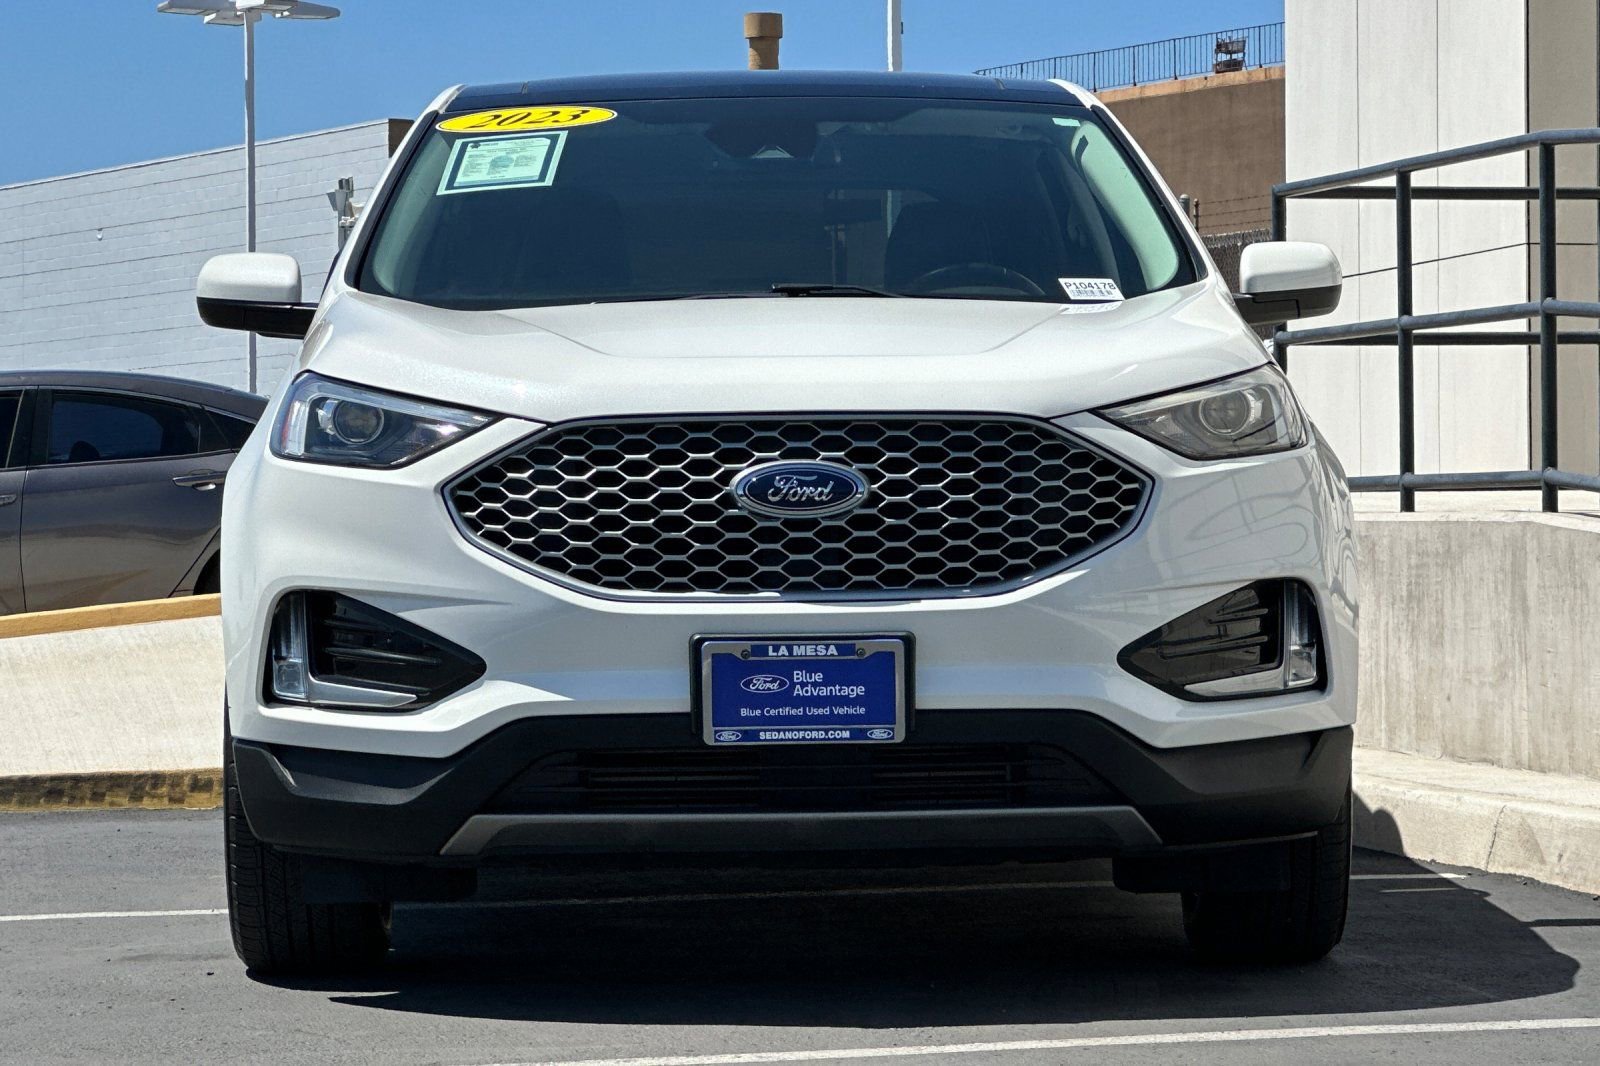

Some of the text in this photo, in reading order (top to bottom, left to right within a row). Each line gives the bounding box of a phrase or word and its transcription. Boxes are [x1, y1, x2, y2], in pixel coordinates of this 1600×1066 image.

[466, 109, 591, 129] 2023
[767, 474, 834, 502] Ford
[768, 645, 838, 656] LA MESA
[793, 670, 823, 683] Blue
[749, 677, 780, 690] Ford
[793, 684, 865, 698] Advantage
[740, 705, 866, 716] Blue Certified Used Vehicle
[759, 730, 850, 740] SEDANOFORD.COM
